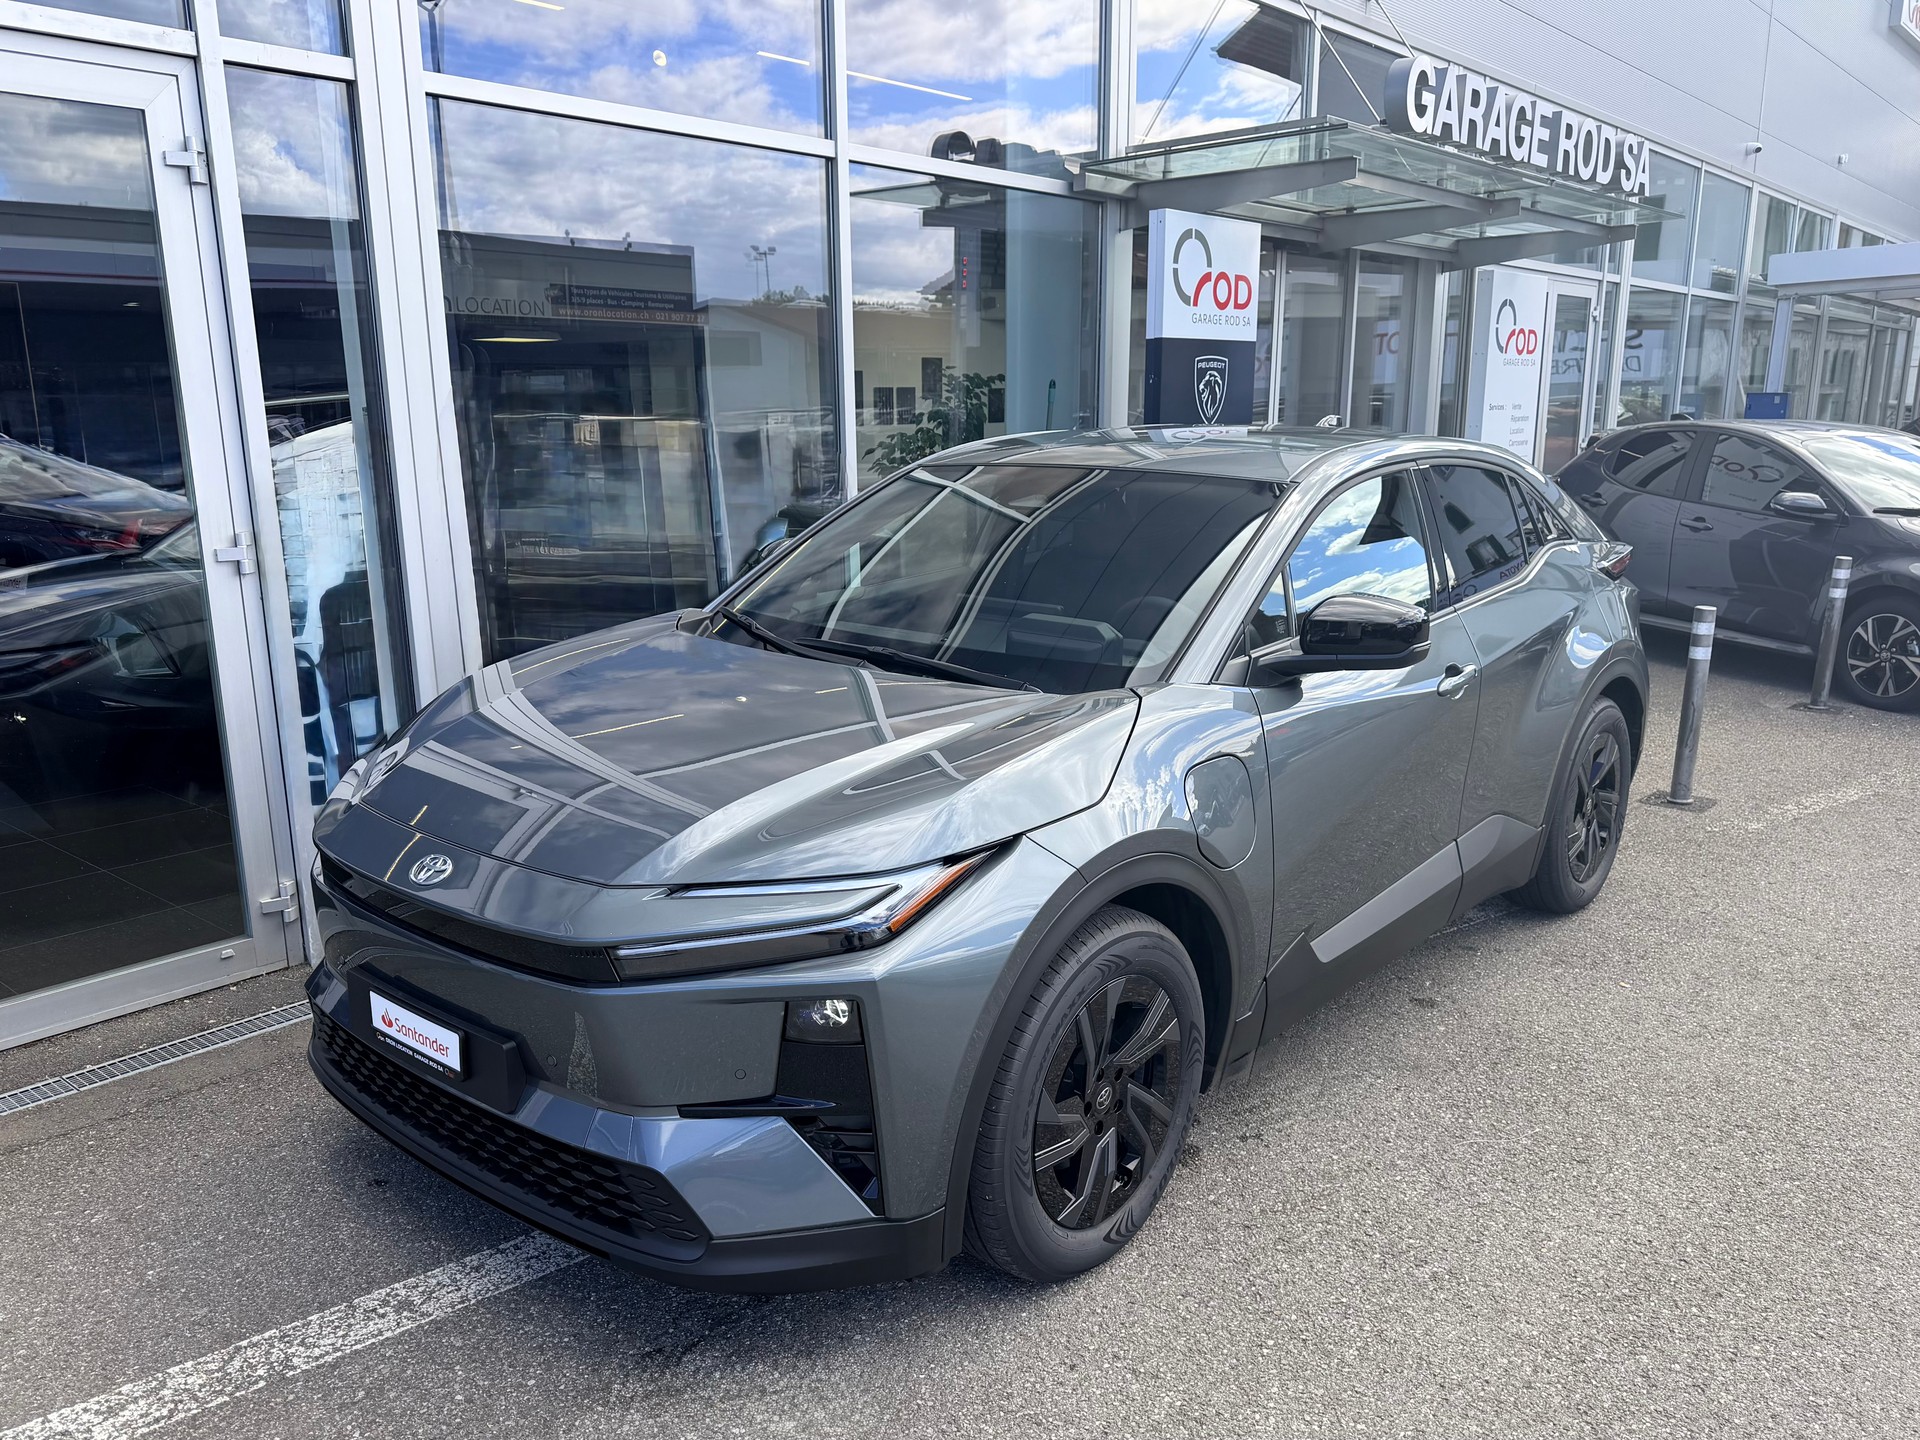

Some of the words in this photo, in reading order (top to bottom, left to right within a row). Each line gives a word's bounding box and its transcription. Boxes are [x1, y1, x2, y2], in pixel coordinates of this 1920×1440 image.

[1406, 55, 1552, 169] GARAGE
[1556, 112, 1616, 186] ROD
[1620, 134, 1650, 197] SA
[456, 295, 545, 316] LOCATION
[620, 299, 645, 308] Camping
[1191, 313, 1222, 325] GARAGE
[1225, 315, 1240, 326] ROD
[1242, 316, 1251, 327] SA
[1198, 361, 1226, 369] PEUGEOT
[1502, 357, 1520, 367] GARAGE
[1520, 358, 1530, 367] ROD
[1530, 358, 1536, 367] SA
[395, 1018, 450, 1058] Santander
[414, 1052, 429, 1065] GARAGE
